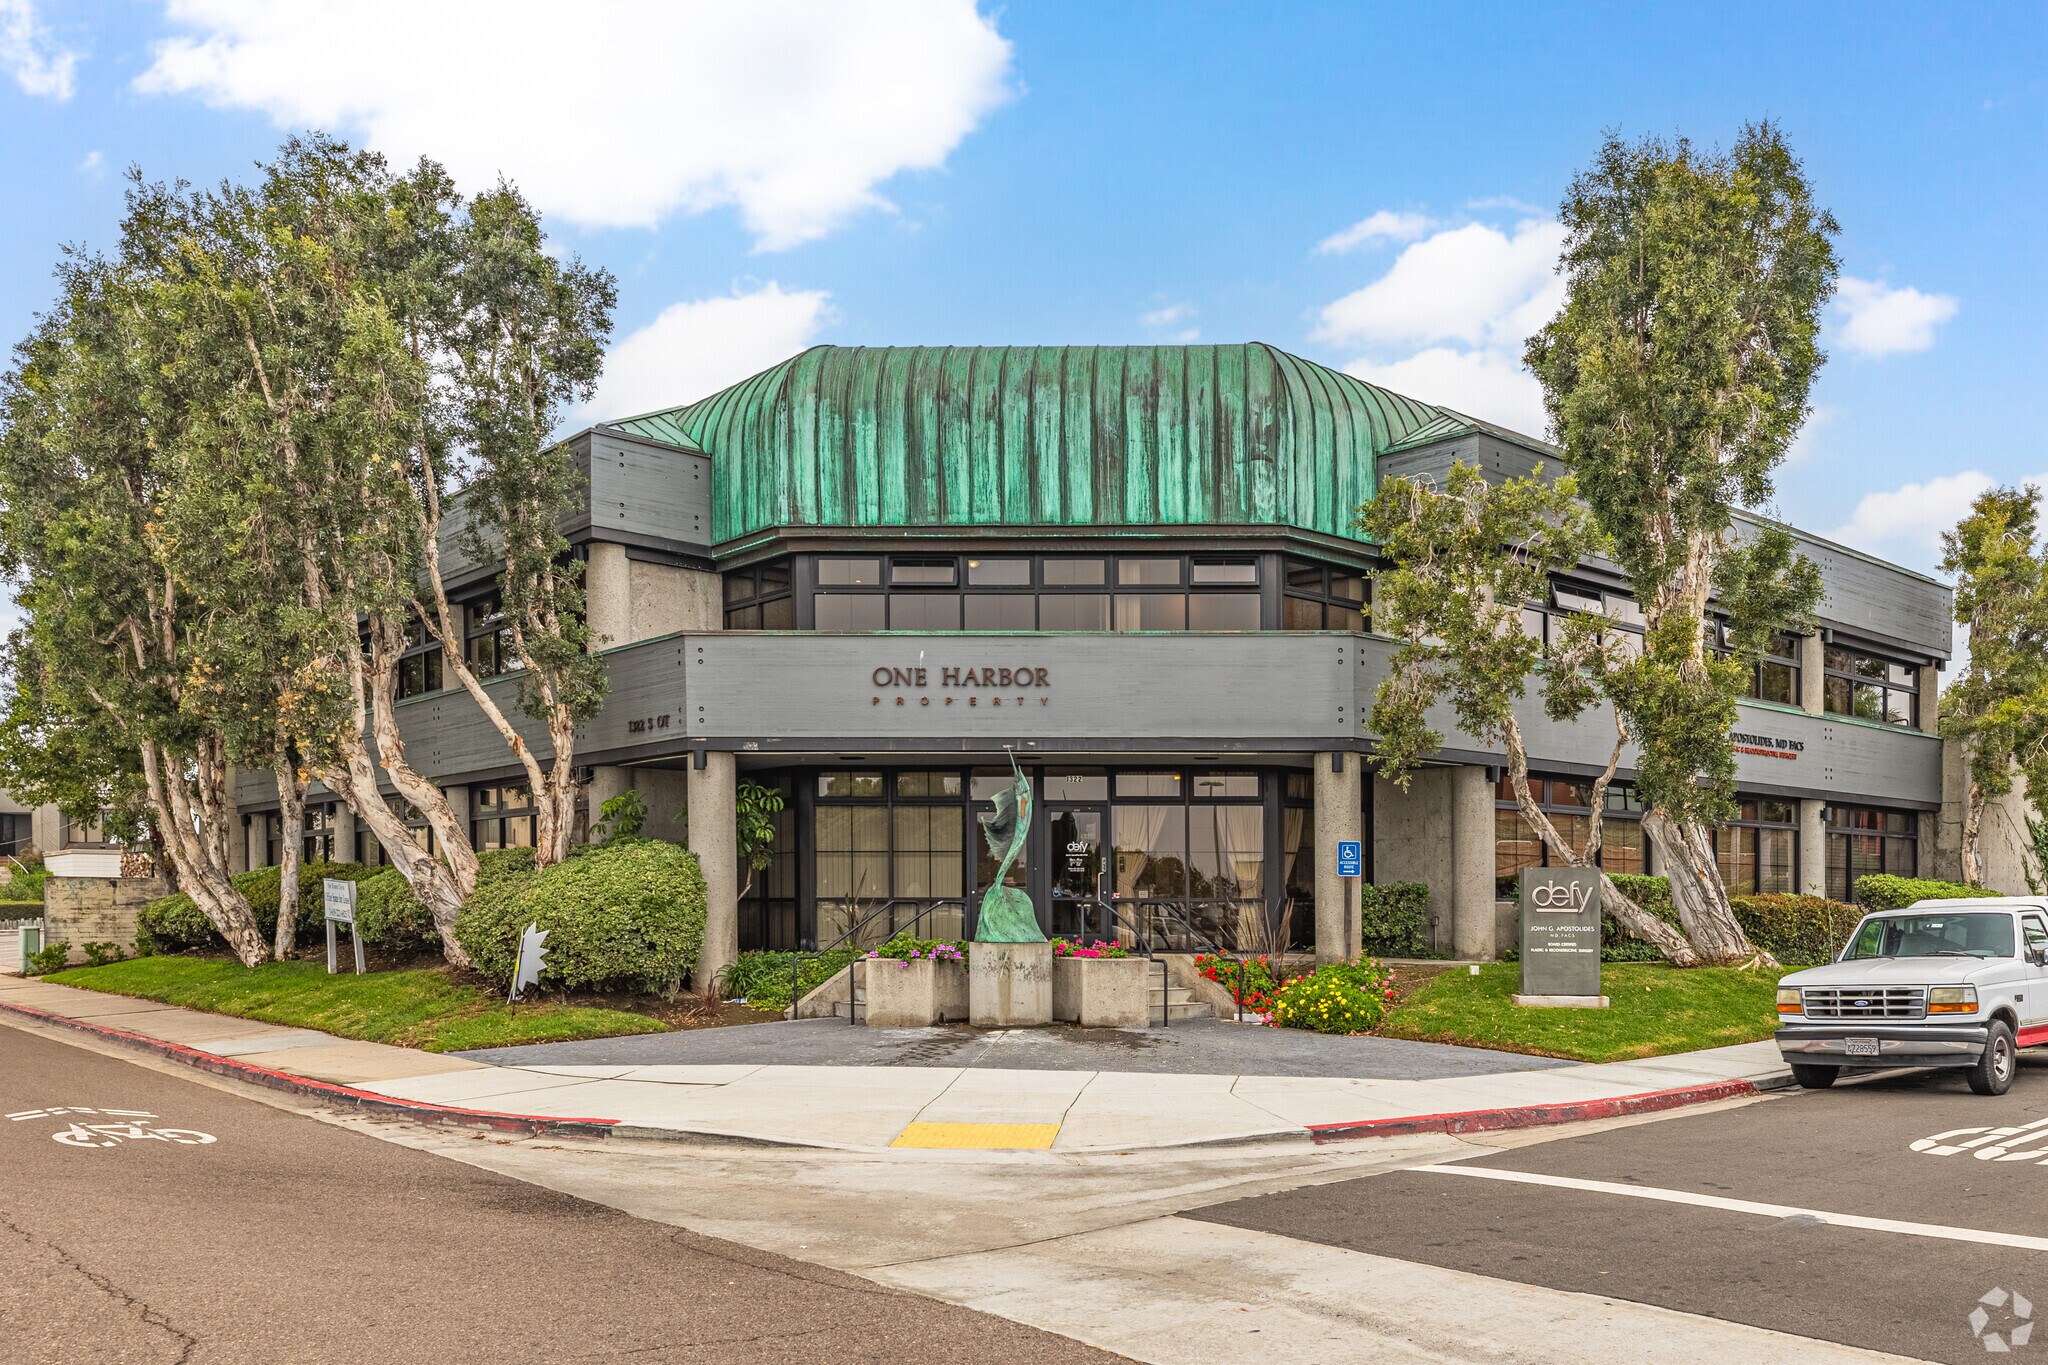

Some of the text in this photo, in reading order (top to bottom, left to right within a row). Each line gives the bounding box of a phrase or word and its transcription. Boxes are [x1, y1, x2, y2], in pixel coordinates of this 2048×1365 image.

[872, 667, 1050, 686] ONE HARBOR
[872, 696, 1048, 706] PROPERTY
[1776, 738, 1787, 749] MD
[1067, 841, 1088, 853] defy
[1531, 880, 1594, 913] defy
